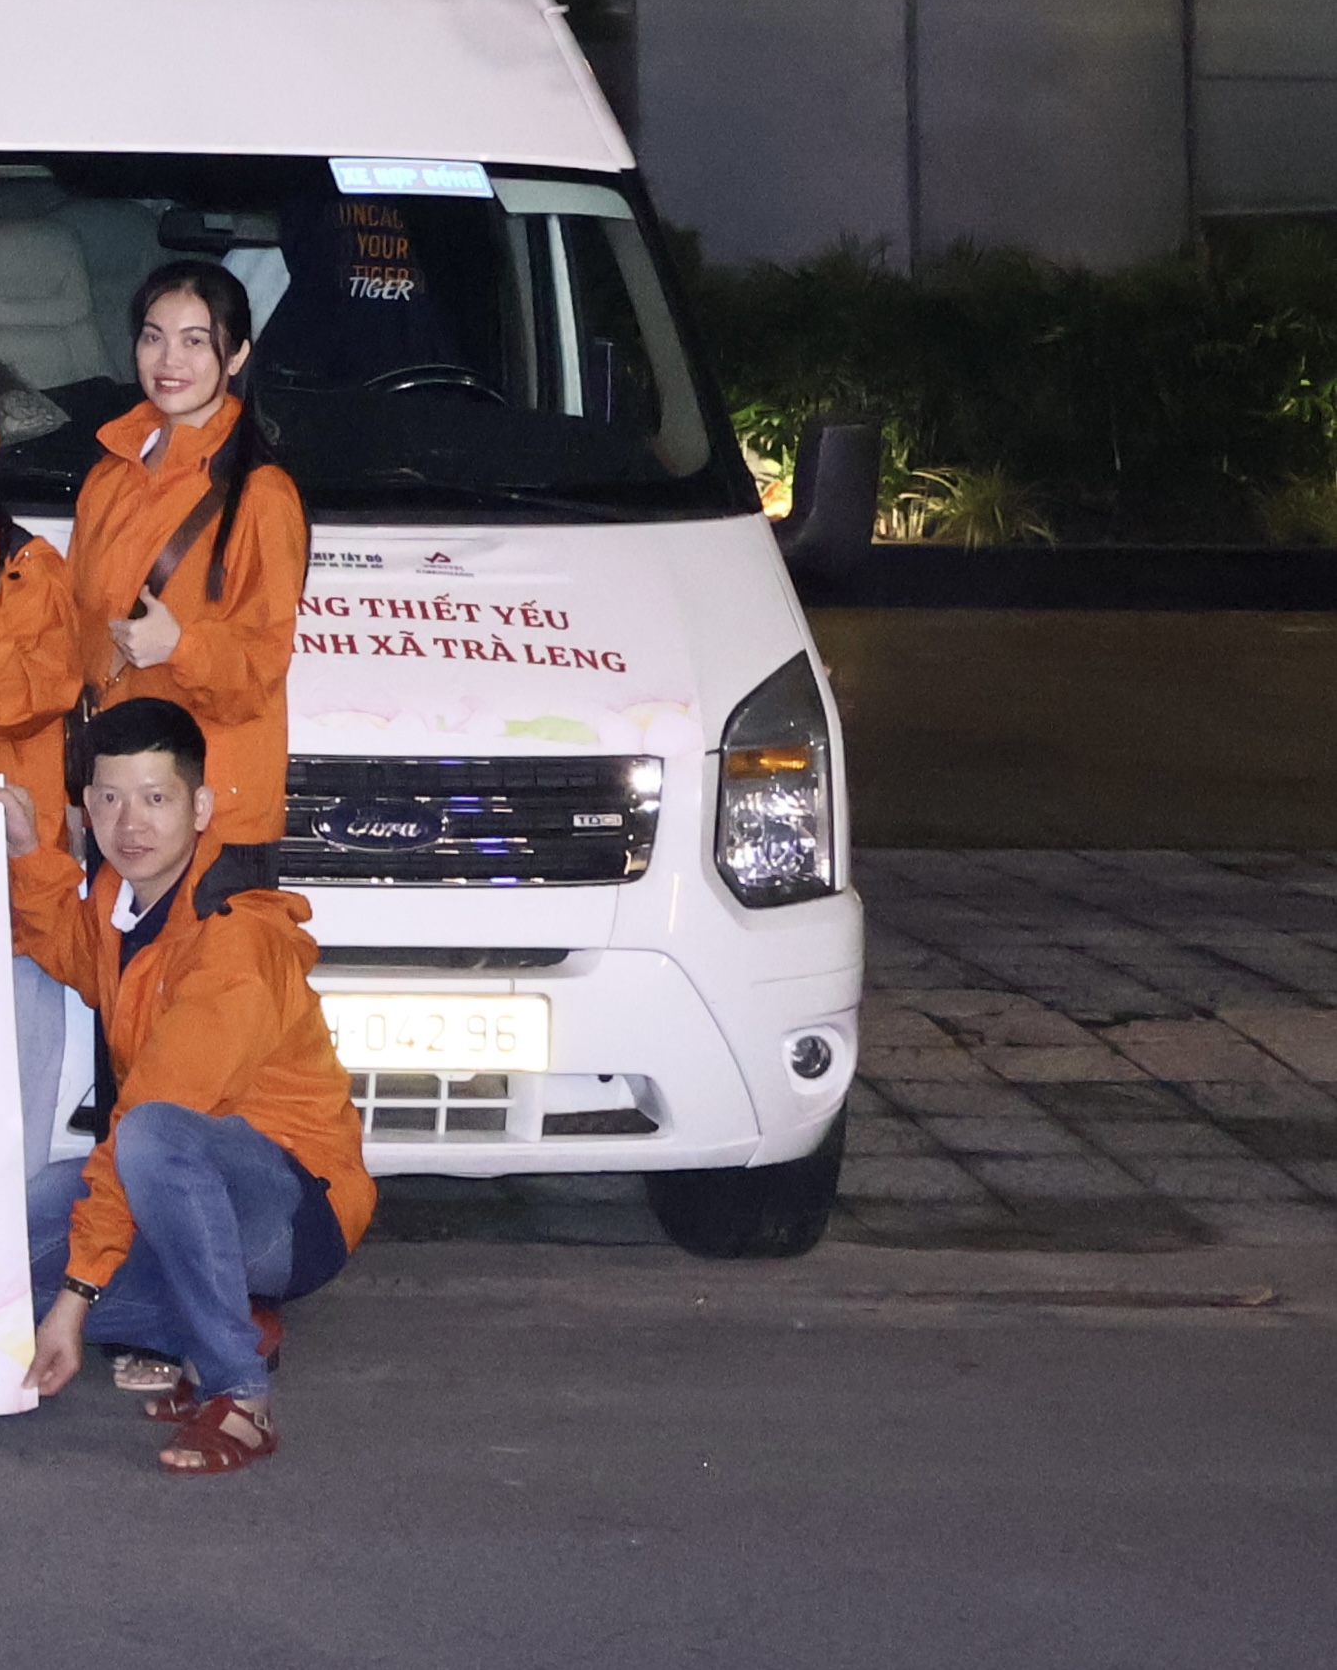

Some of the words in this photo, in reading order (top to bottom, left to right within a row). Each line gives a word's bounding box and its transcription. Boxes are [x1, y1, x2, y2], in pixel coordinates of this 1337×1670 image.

[357, 232, 410, 260] YOUR
[349, 277, 415, 302] TIGER
[297, 596, 351, 617] NG
[359, 593, 482, 624] THIẾT
[490, 600, 571, 631] YẾU
[292, 633, 359, 655] NH
[369, 631, 428, 658] XÃ
[433, 633, 518, 663] TRÀ
[522, 643, 627, 674] LENG
